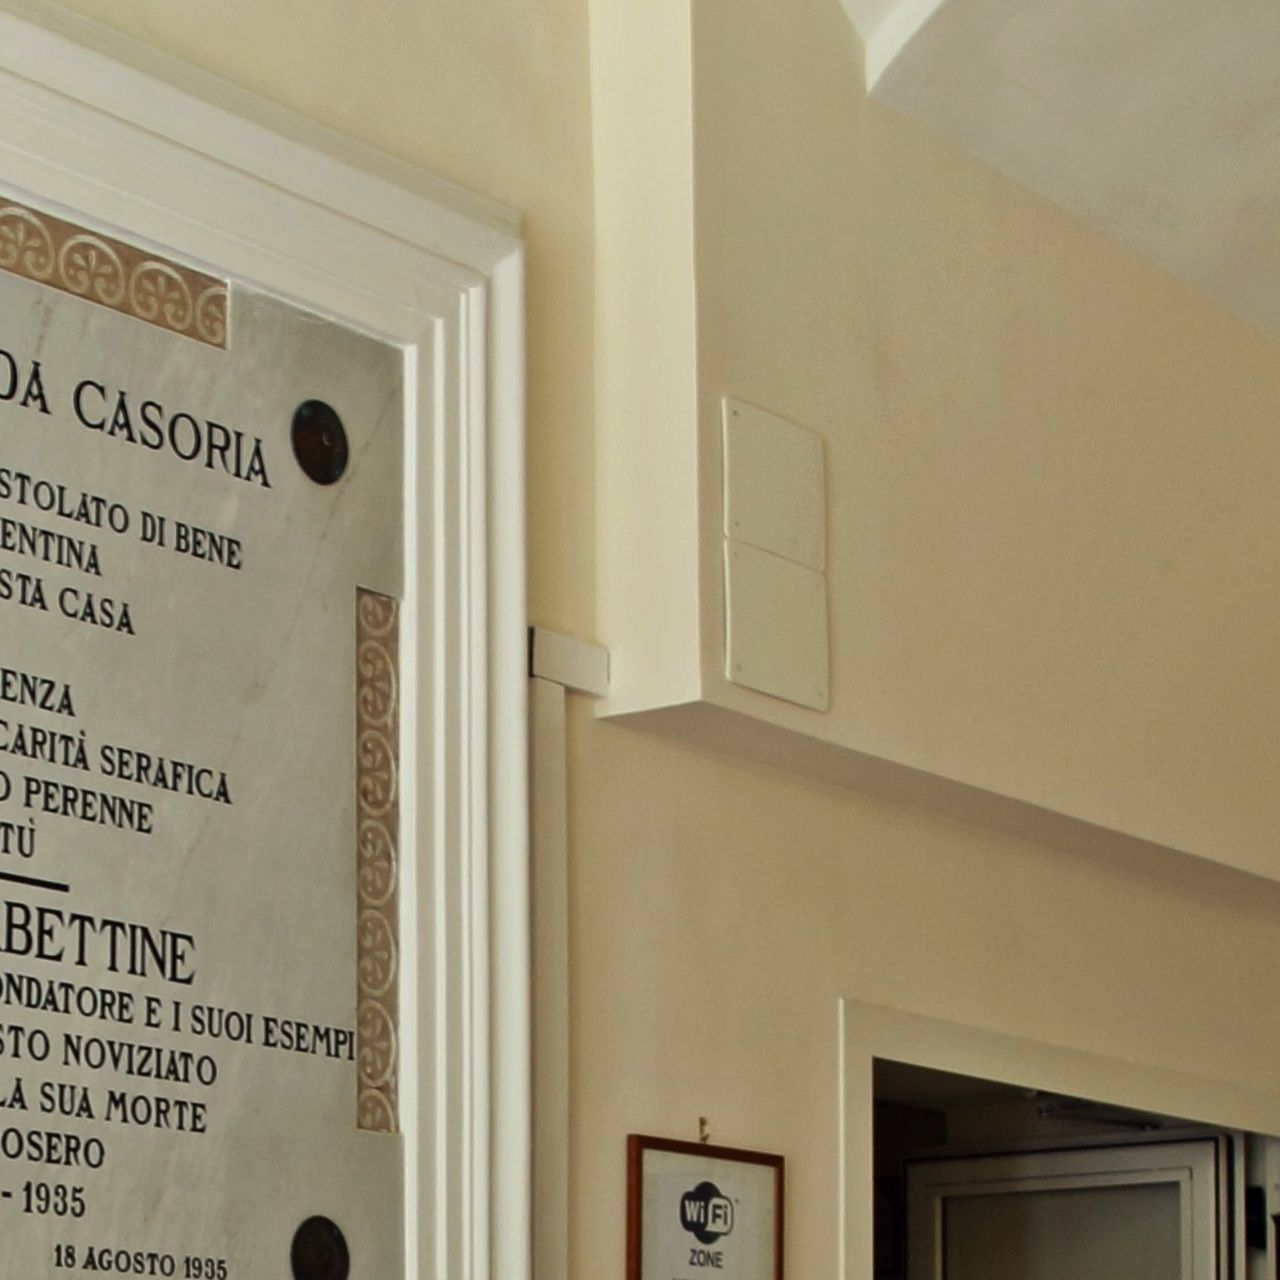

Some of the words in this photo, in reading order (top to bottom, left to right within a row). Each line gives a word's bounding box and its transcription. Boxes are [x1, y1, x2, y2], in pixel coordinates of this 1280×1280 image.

[72, 379, 272, 489] CASORIA
[139, 510, 167, 548] DI
[173, 521, 243, 571] BENE
[58, 586, 136, 636] CASA
[100, 744, 233, 805] SERAFICA
[23, 775, 154, 835] PERENNE
[143, 995, 163, 1029] E
[172, 1000, 182, 1033] I
[190, 1004, 254, 1045] SUOI
[261, 1015, 357, 1061] ESEMPI
[62, 1032, 218, 1087] NOVIZIATO
[39, 1081, 96, 1120] SUA
[104, 1089, 207, 1134] MORTE
[22, 1180, 86, 1219] 1935
[54, 1243, 77, 1269] 18
[81, 1246, 176, 1278] AGOSTO
[688, 1248, 724, 1269] ZONE
